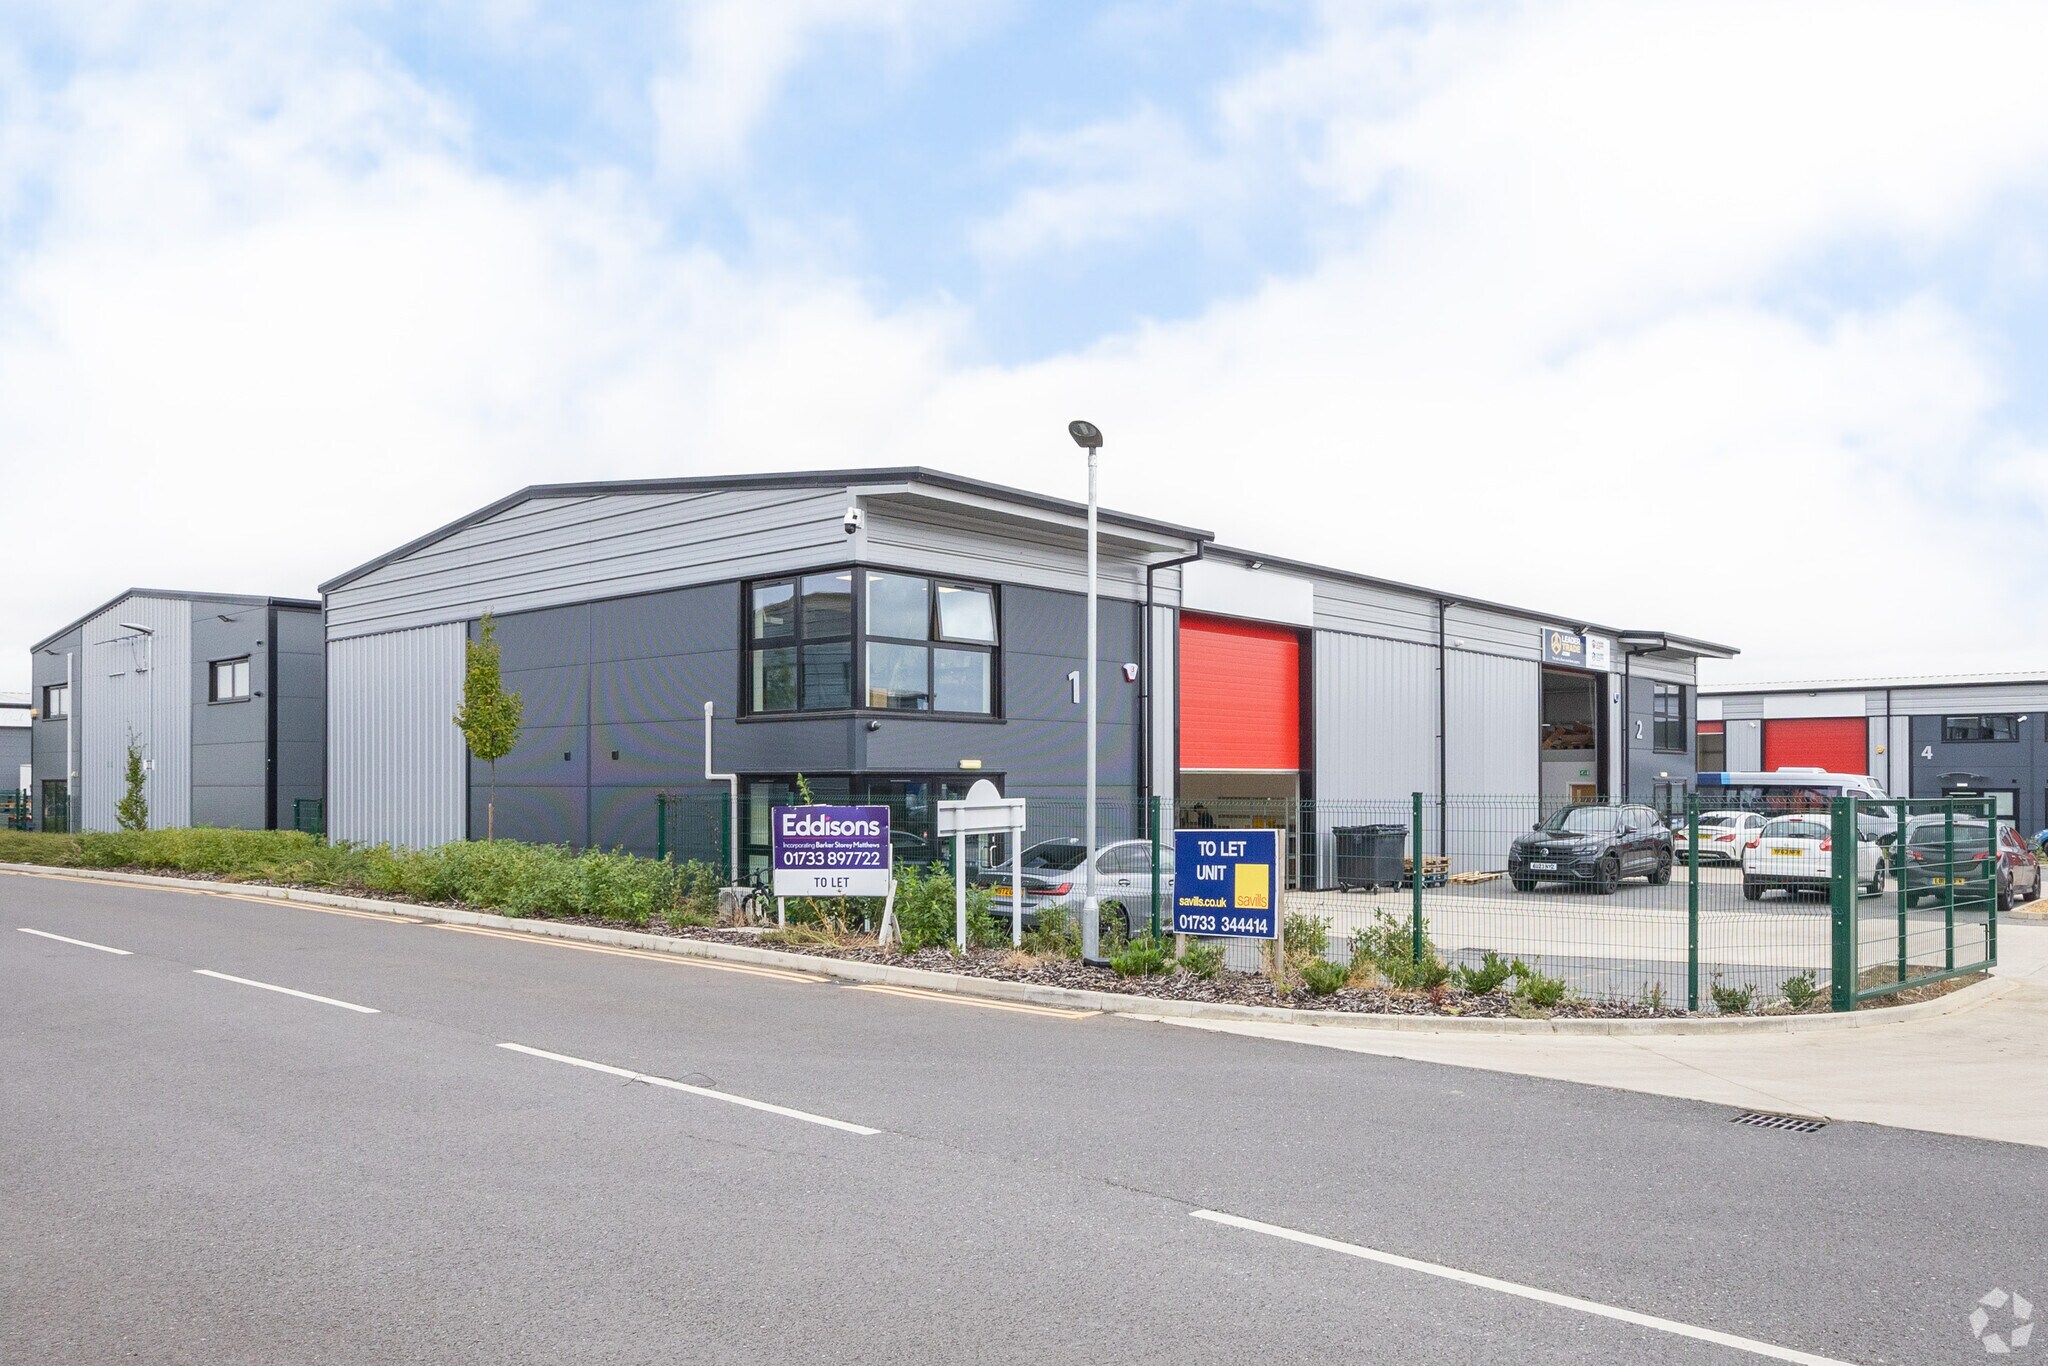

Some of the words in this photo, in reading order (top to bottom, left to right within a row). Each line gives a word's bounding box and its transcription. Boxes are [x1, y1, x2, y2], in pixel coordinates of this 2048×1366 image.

[1561, 635, 1581, 645] LEADER
[1561, 643, 1581, 654] TRADE
[1068, 670, 1080, 704] 1
[1636, 720, 1643, 739] 2
[1921, 745, 1933, 760] 4
[783, 813, 880, 836] Eddisons
[783, 841, 815, 849] Incorporating
[834, 841, 852, 849] Storey
[1198, 841, 1217, 856] TO
[1220, 841, 1247, 857] LET
[783, 852, 825, 866] 01733
[827, 852, 880, 866] 897722
[1196, 865, 1227, 881] UNIT
[814, 877, 827, 888] TO
[831, 877, 850, 888] LET
[1179, 896, 1227, 908] savills.co.uk
[1237, 893, 1267, 908] savills
[1179, 914, 1216, 931] 01733
[1221, 916, 1268, 934] 344414
